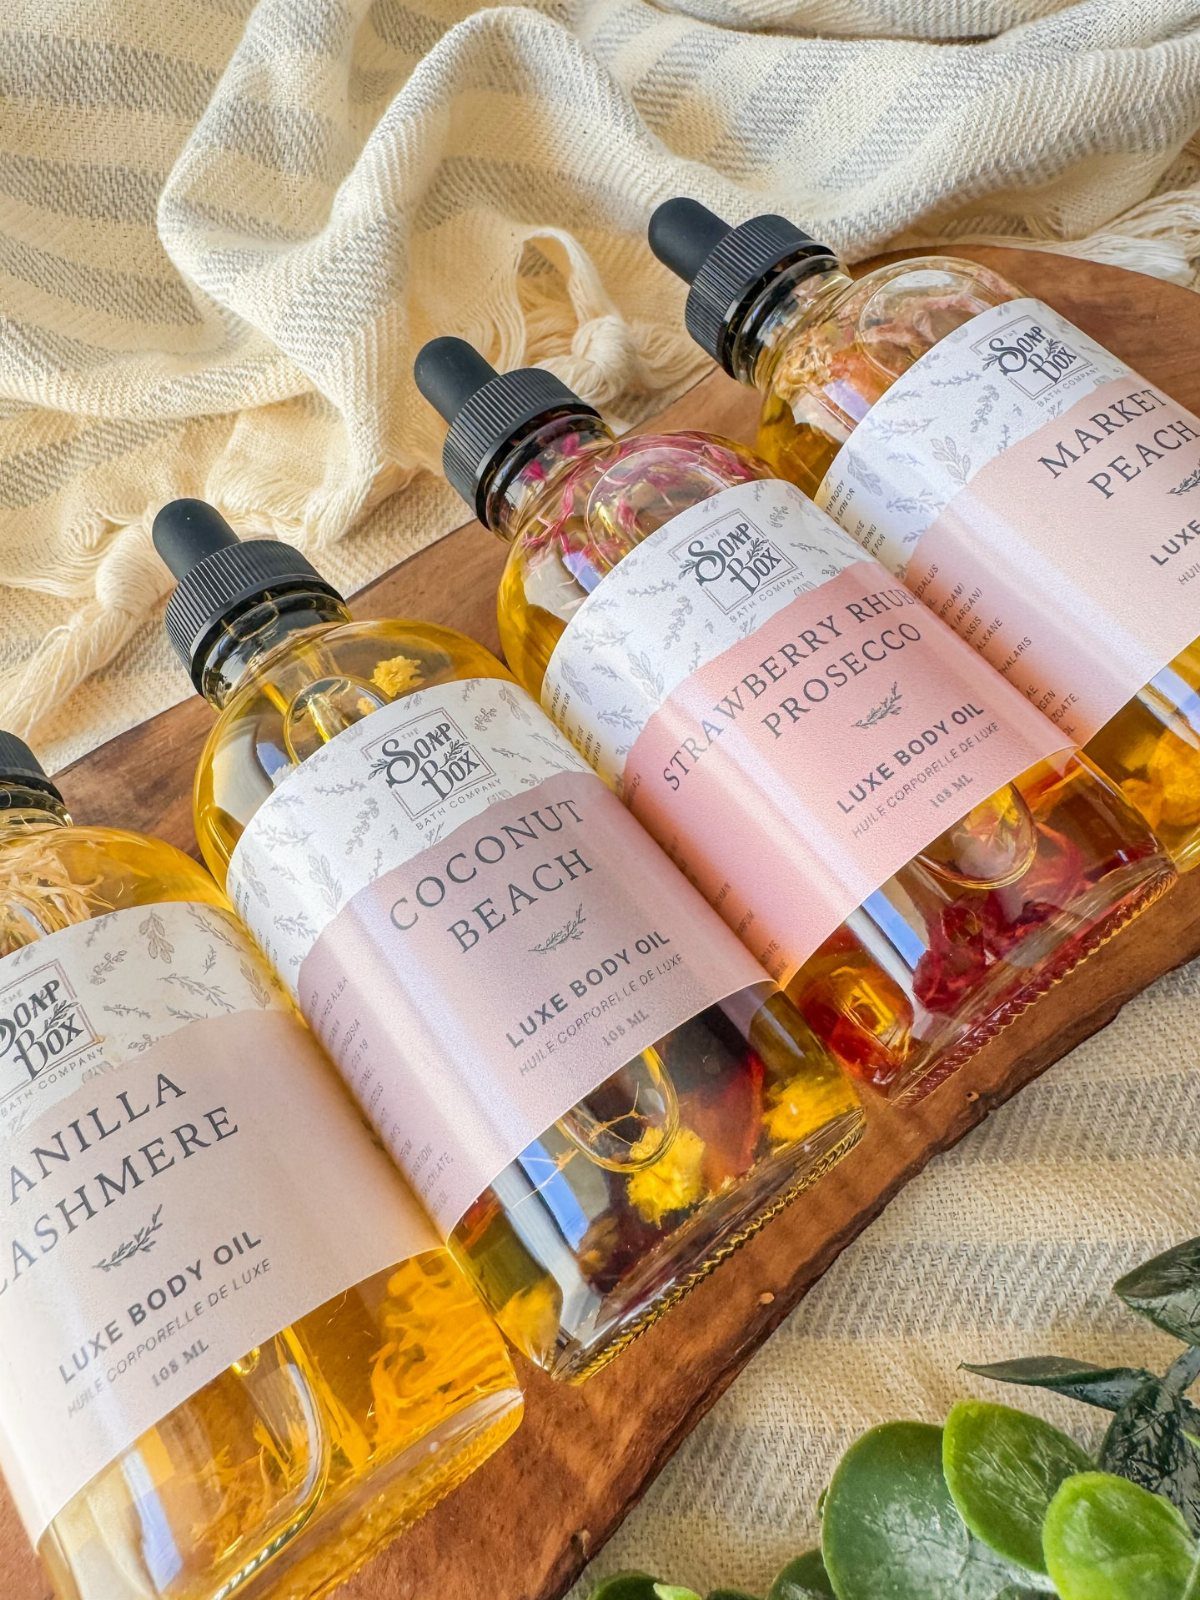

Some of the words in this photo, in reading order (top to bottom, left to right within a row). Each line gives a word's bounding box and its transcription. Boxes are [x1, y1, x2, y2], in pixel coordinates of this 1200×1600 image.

[988, 326, 1047, 376] SOAP
[1028, 347, 1077, 383] BOX
[1036, 388, 1062, 408] BATH
[1062, 367, 1100, 390] COMPANY
[1037, 389, 1168, 480] MARKET
[1087, 420, 1200, 500] PEACH
[688, 523, 752, 586] SOAP
[727, 547, 782, 594] BOX
[729, 602, 756, 623] BATH
[758, 571, 805, 601] COMPANY
[663, 615, 843, 791] STRAWBERRY
[760, 623, 922, 739] PROSECCO
[382, 722, 452, 789] SOAP
[420, 750, 480, 800] BOX
[836, 763, 895, 814] LUXE
[893, 720, 949, 767] BODY
[951, 703, 984, 725] OIL
[853, 804, 887, 839] HUILE
[886, 748, 959, 808] CORPORELLE
[959, 737, 974, 753] DE
[974, 722, 1000, 743] LUXE
[951, 774, 973, 792] ML
[415, 808, 447, 830] BATH
[449, 778, 502, 809] COMPANY
[390, 800, 584, 931] COCONUT
[447, 848, 593, 954] BEACH
[506, 993, 568, 1048] LUXE
[569, 948, 631, 998] BODY
[635, 931, 671, 955] OIL
[519, 1039, 557, 1076] HUILE
[557, 980, 637, 1044] CORPORELLE
[639, 970, 655, 986] DE
[656, 953, 684, 975] LUXE
[626, 1009, 650, 1028] ML
[0, 1090, 34, 1118] BATH
[38, 1047, 104, 1090] COMPANY
[13, 1013, 84, 1081] BOX
[10, 1073, 187, 1206] ANILLA
[58, 1320, 124, 1384] LUXE
[127, 1259, 203, 1327] BODY
[213, 1231, 262, 1265] OIL
[106, 1302, 204, 1384] CORPORELLE
[207, 1284, 229, 1308] DE
[232, 1258, 273, 1291] LUXE
[151, 1360, 180, 1387] 108
[182, 1339, 210, 1364] ML
